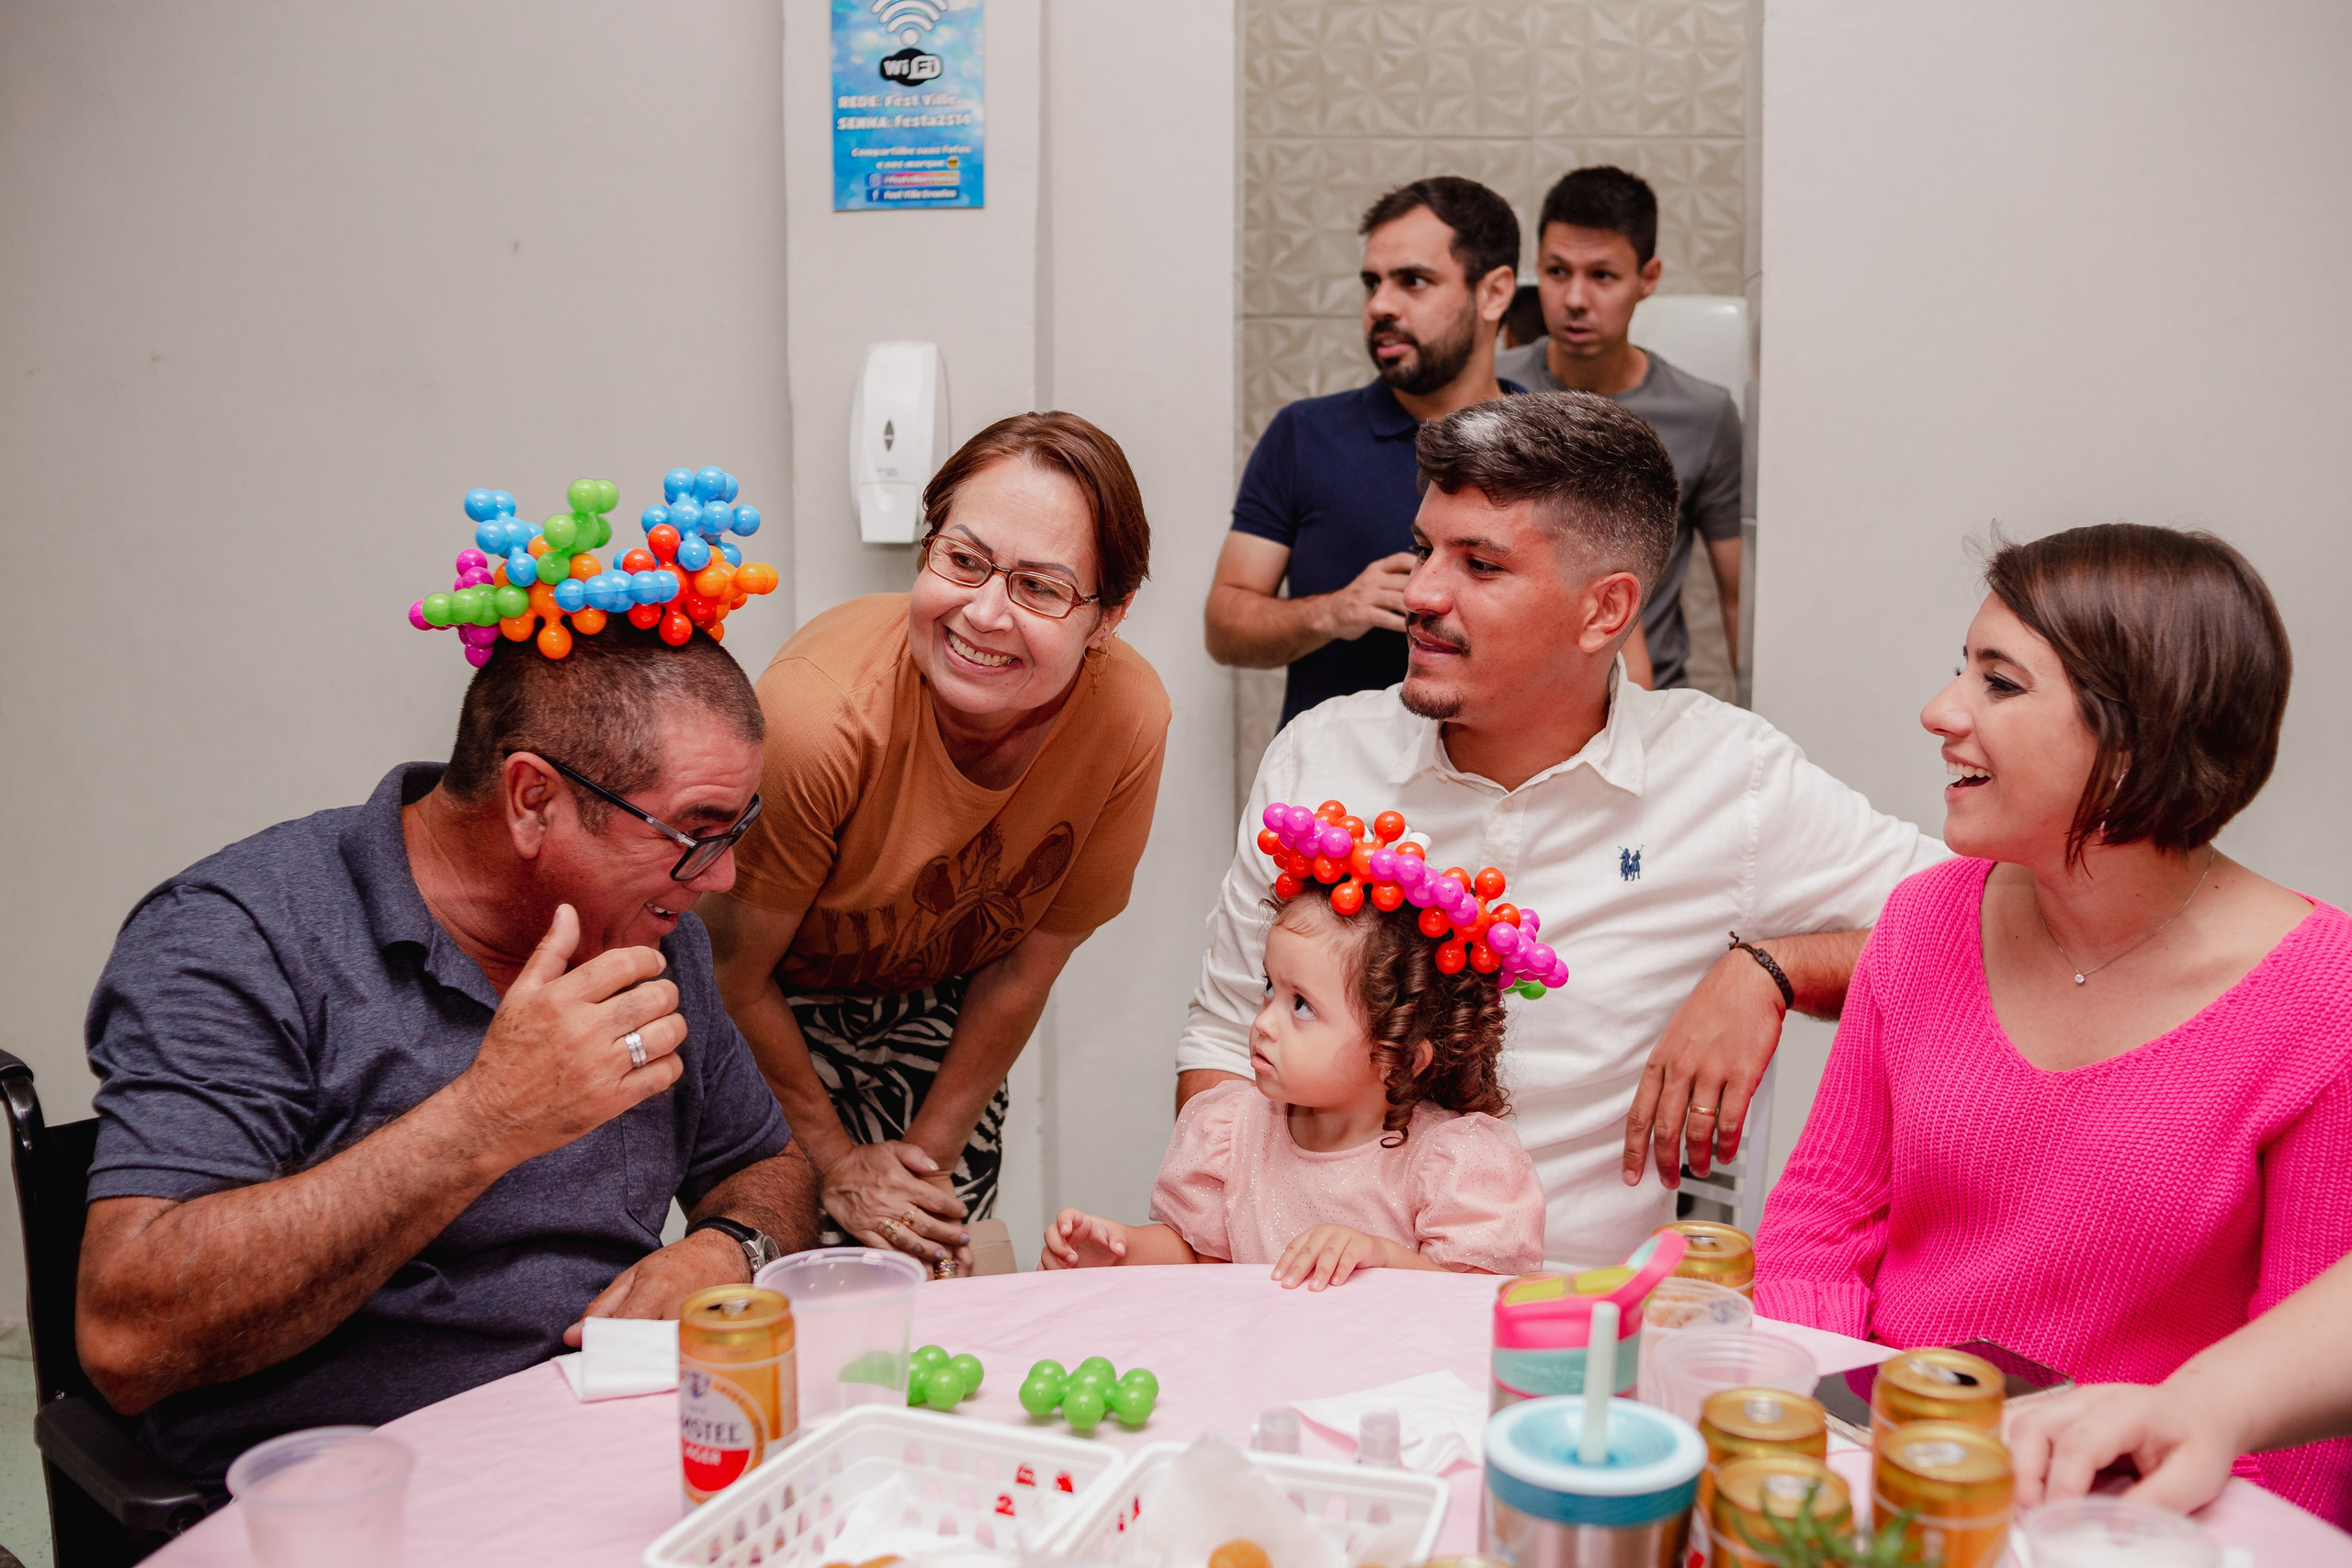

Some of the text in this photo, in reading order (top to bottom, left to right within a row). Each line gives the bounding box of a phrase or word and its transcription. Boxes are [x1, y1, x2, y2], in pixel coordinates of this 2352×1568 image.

[837, 92, 957, 108] REDE: Fest Ville
